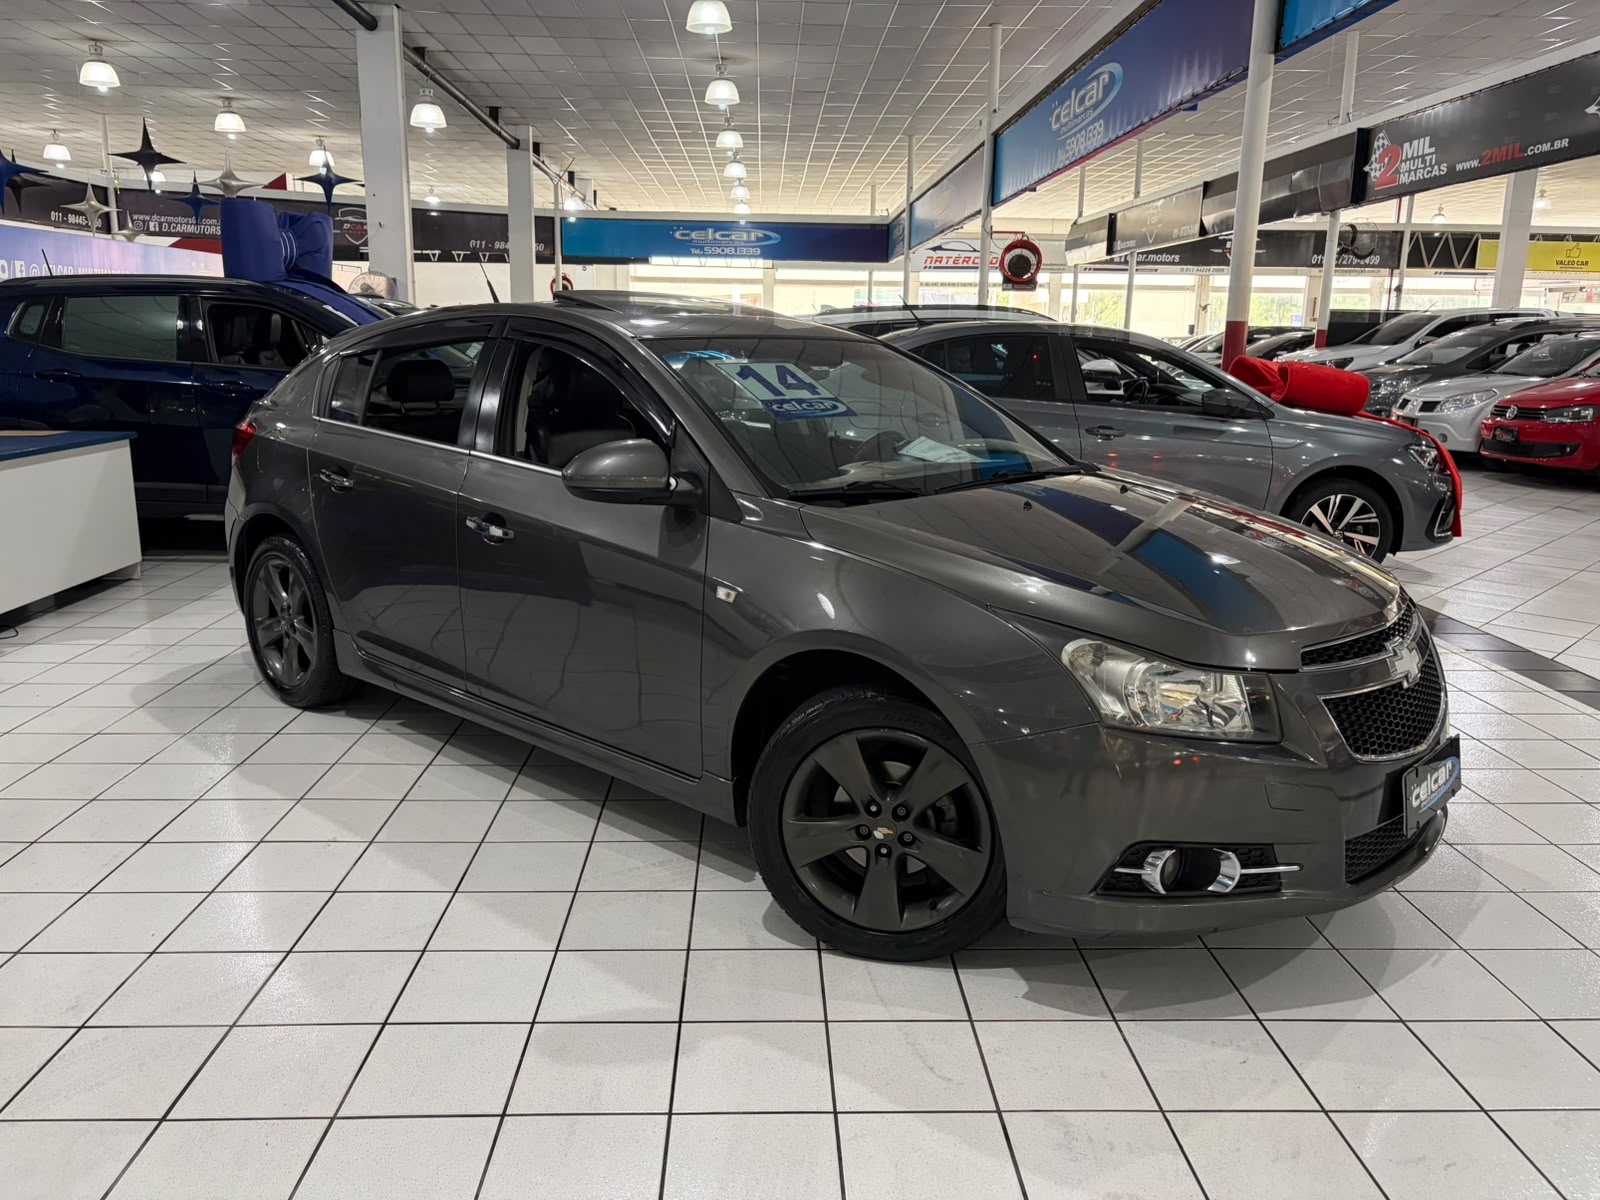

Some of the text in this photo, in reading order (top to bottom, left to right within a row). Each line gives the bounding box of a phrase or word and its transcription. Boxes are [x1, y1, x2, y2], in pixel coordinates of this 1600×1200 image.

[1052, 71, 1110, 131] celcar
[1375, 136, 1436, 190] 2 MIL
[1401, 154, 1437, 173] MULTI
[1399, 163, 1448, 185] MARCAS
[50, 211, 62, 222] 011
[470, 240, 486, 249] 011
[674, 228, 764, 241] celcar
[736, 364, 822, 397] 14
[771, 401, 834, 412] celcar
[1412, 760, 1453, 808] celcar
